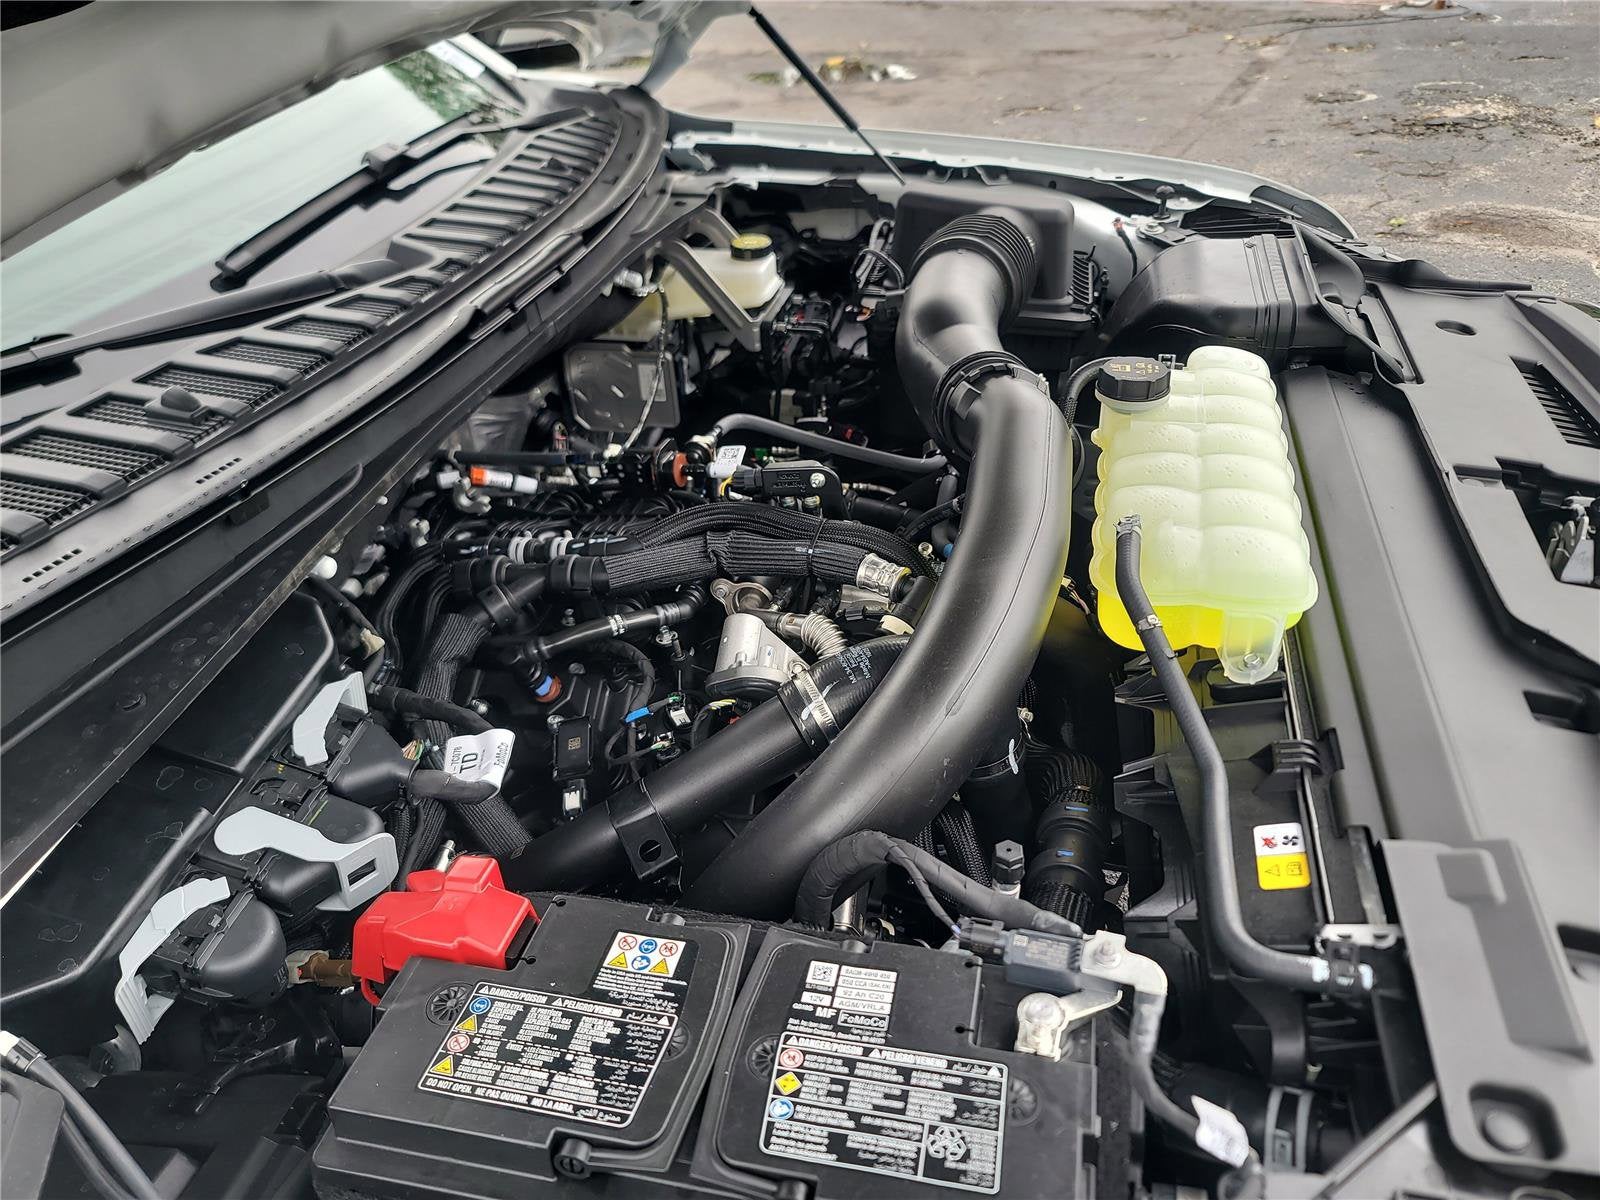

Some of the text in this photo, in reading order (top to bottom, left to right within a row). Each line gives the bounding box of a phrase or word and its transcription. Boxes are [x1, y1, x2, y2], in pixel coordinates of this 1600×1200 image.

[459, 753, 478, 774] TD
[489, 986, 548, 1005] DANGER/POISON
[562, 998, 624, 1018] PELIGRO/VENENO
[815, 1006, 838, 1019] MF
[425, 1077, 473, 1094] DO NOT OPEN.
[485, 1089, 501, 1099] PAS
